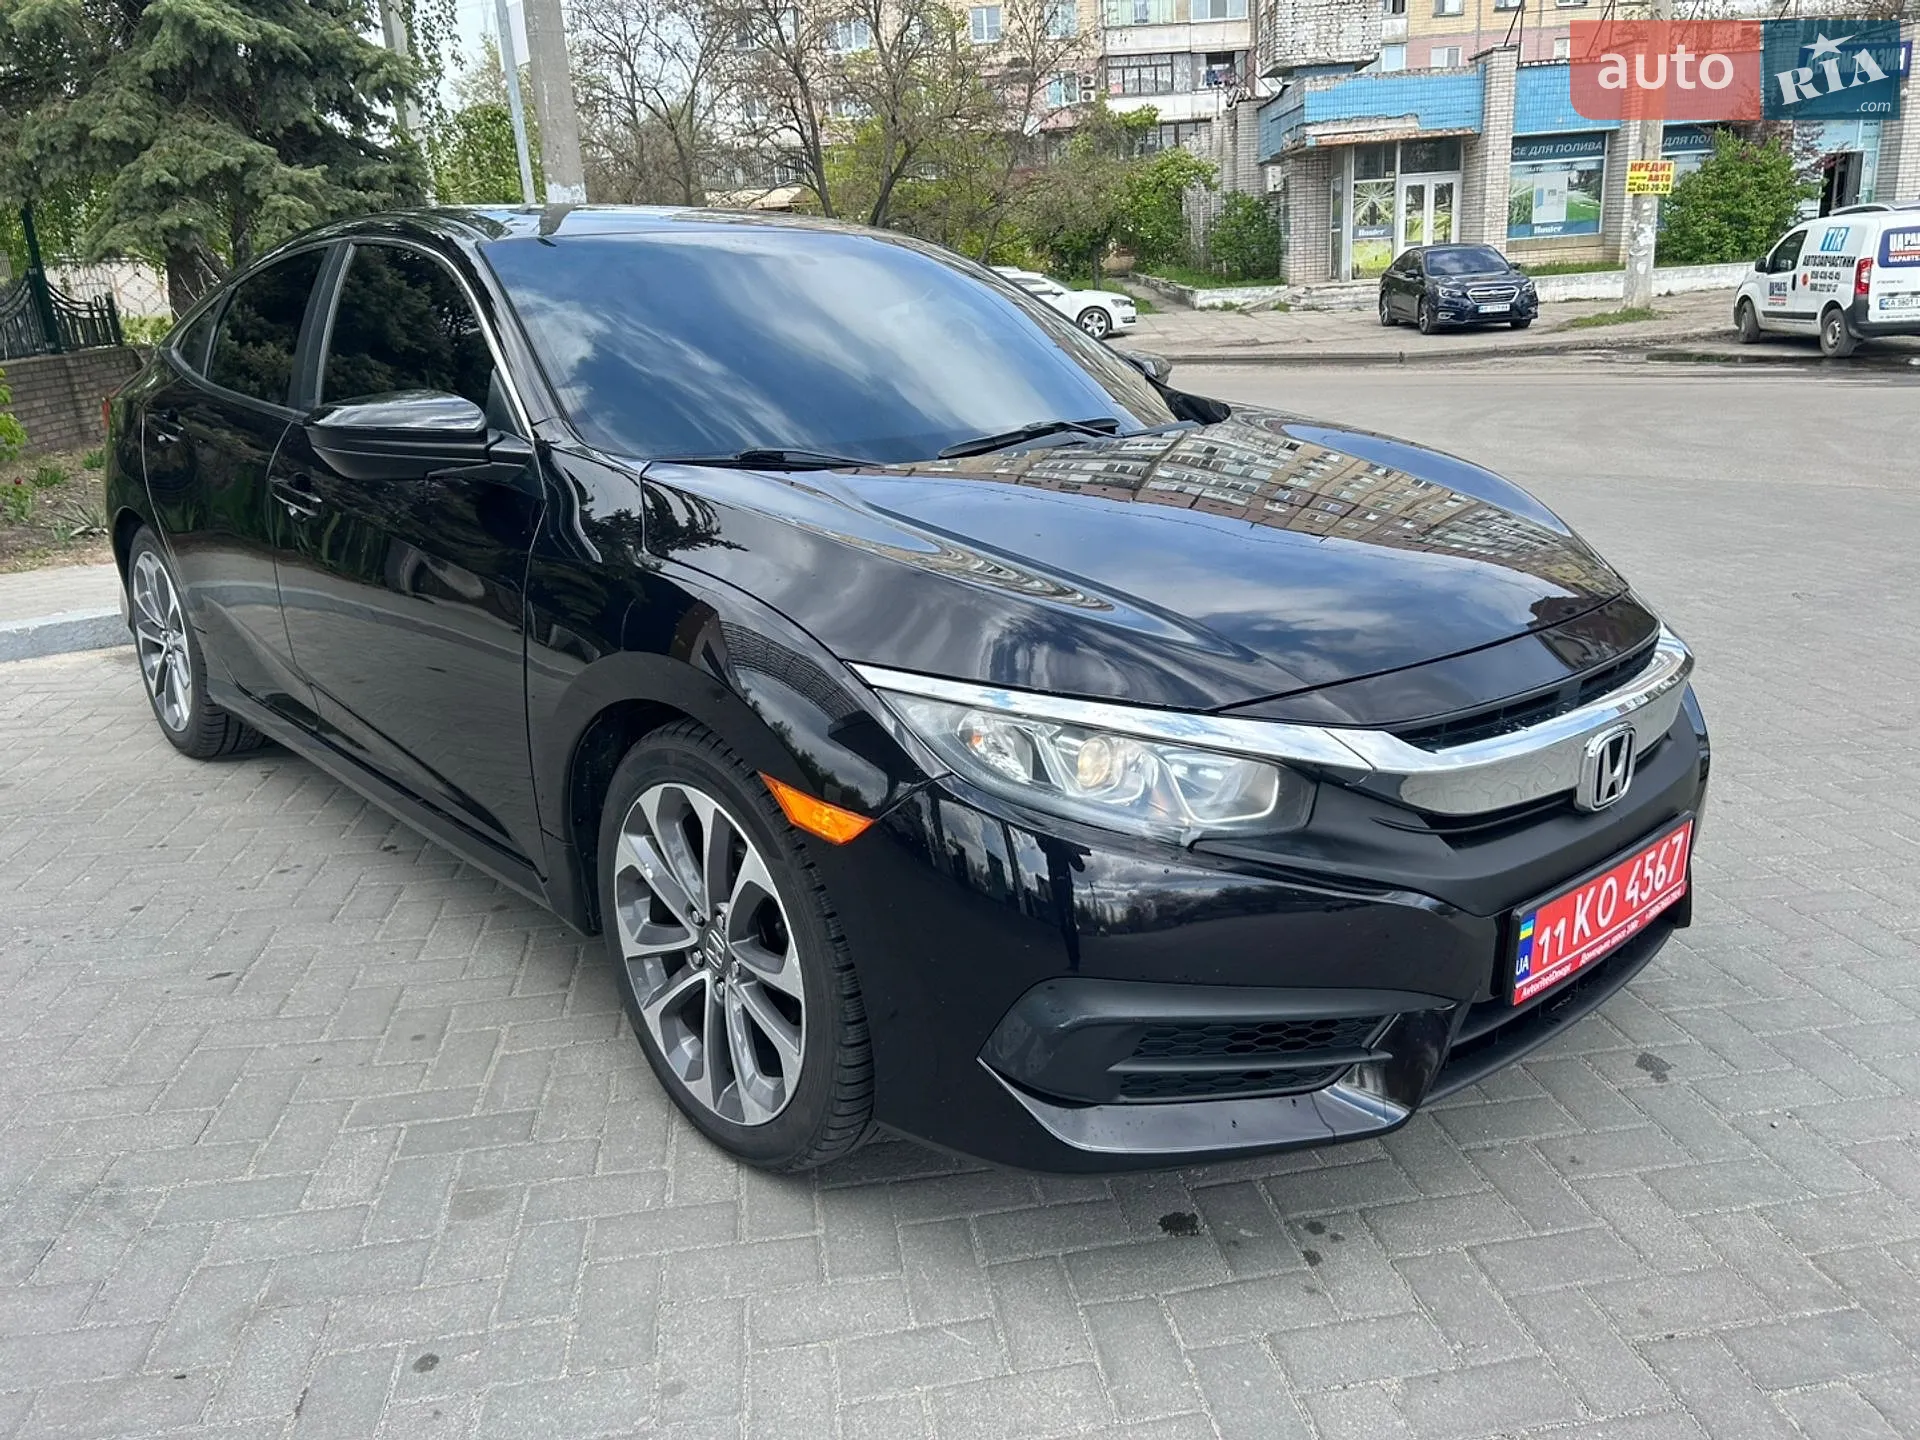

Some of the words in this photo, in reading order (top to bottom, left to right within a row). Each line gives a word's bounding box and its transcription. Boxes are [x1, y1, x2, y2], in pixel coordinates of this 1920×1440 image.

[1511, 146, 1527, 156] СЕ
[1528, 144, 1553, 157] ДЛЯ
[1555, 141, 1603, 153] ПОЛИВА
[1663, 135, 1689, 147] ДЛЯ
[1630, 162, 1673, 172] КРЕДИТ
[1647, 173, 1671, 182] АВТО
[1821, 228, 1848, 251] TIR
[1624, 831, 1684, 909] 4567
[1515, 954, 1530, 976] UA
